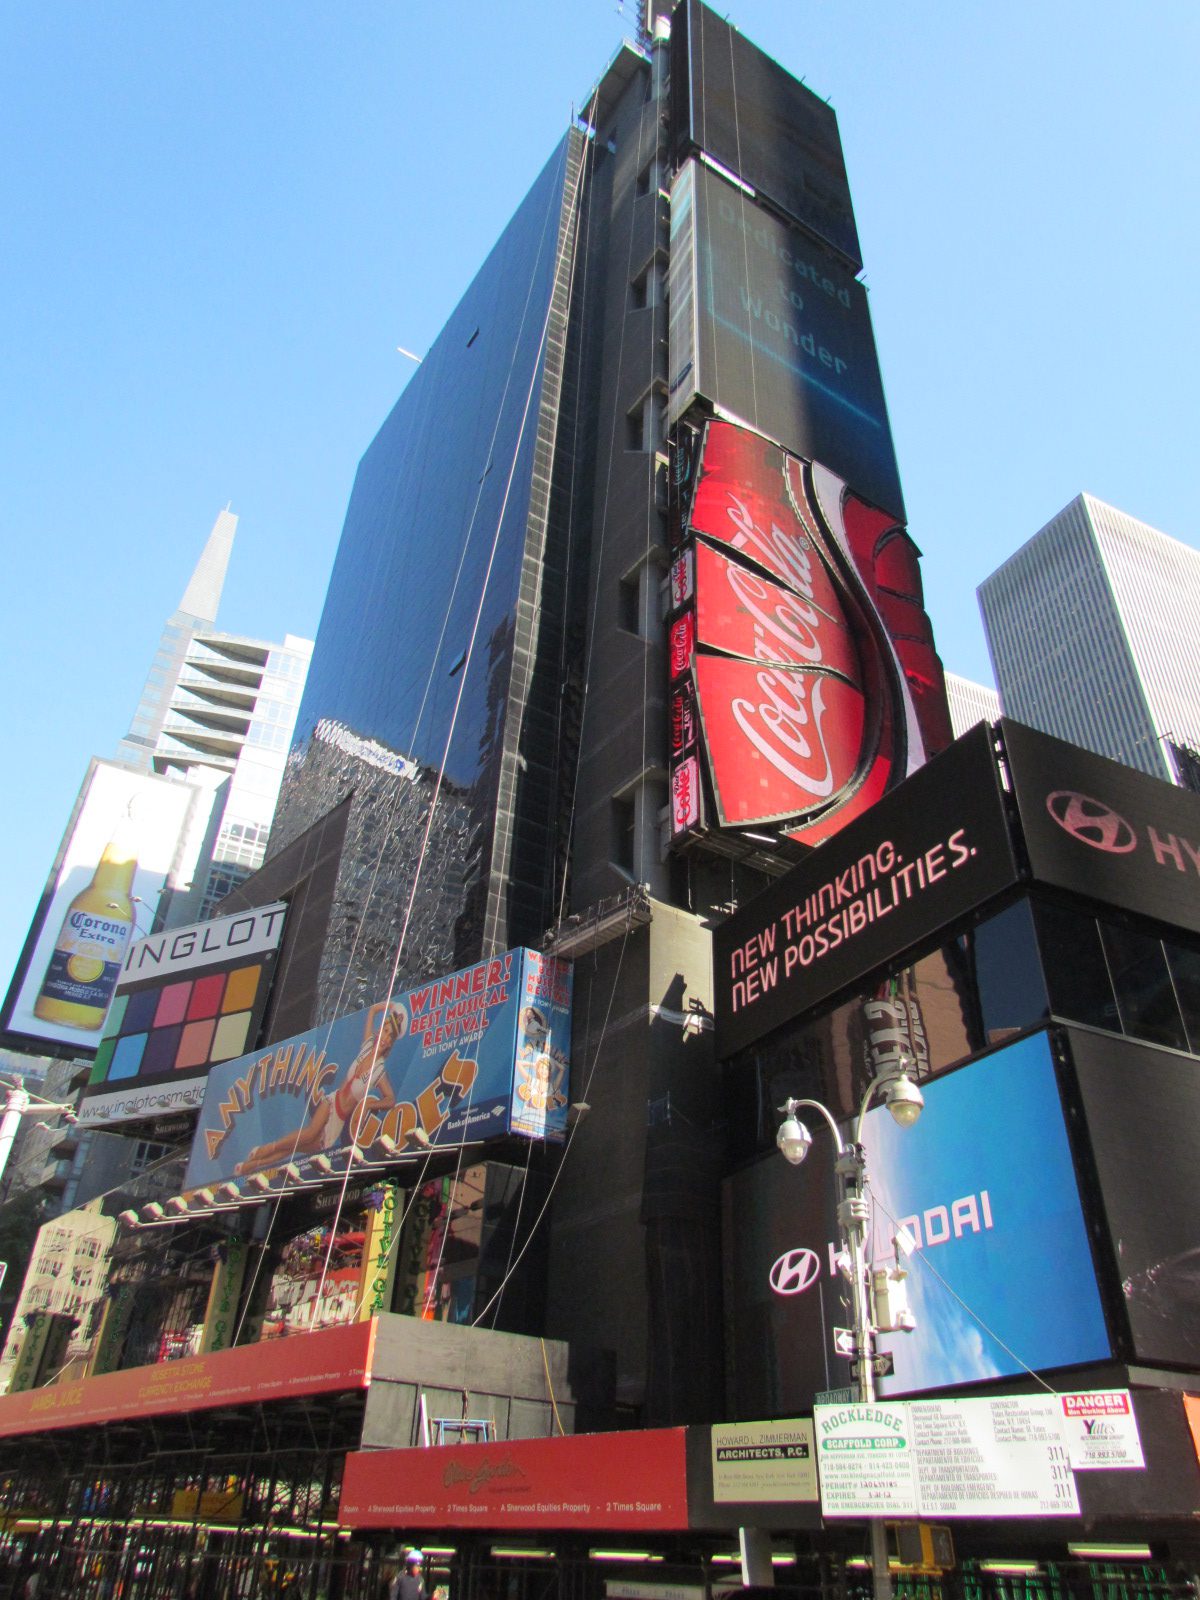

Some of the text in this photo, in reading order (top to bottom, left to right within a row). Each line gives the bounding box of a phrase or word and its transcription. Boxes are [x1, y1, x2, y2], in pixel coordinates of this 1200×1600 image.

[719, 203, 851, 309] Dedicated
[776, 280, 803, 311] to
[739, 286, 847, 374] Wonder
[780, 840, 903, 941] THINKING.
[784, 828, 978, 979] POSSIBILITIES.
[70, 911, 127, 936] Corona
[79, 928, 116, 945] Extra
[125, 908, 286, 972] INGLOT
[408, 954, 513, 1018] WINNER!
[410, 985, 509, 1036] BEST MUSICAL
[422, 1009, 489, 1049] REVIVAL
[438, 1038, 458, 1054] TONY
[459, 1030, 485, 1047] AWARD
[205, 1043, 339, 1160] ANYTHING
[350, 1048, 479, 1151] GOES
[1066, 1394, 1124, 1408] DANGER
[1106, 1406, 1126, 1414] Above
[821, 1408, 903, 1434] ROCKLEDGE
[1083, 1419, 1115, 1435] Yates
[716, 1435, 750, 1446] HOWARD
[760, 1432, 807, 1444] ZIMMERMAN
[827, 1438, 902, 1450] SCAFFOLD CORP.
[719, 1447, 807, 1459] ARCHITECTS, P.C.
[1047, 1446, 1065, 1461] 311
[1050, 1464, 1069, 1480] 311
[827, 1492, 856, 1500] EXPIRES
[1055, 1483, 1072, 1498] 311
[415, 1505, 436, 1514] Property
[452, 1504, 468, 1512] Times
[469, 1504, 488, 1513] Square
[506, 1503, 536, 1511] Sherwood
[537, 1503, 560, 1512] Equities
[562, 1503, 590, 1513] Property
[606, 1502, 611, 1511] 2
[613, 1502, 634, 1511] Times
[635, 1501, 662, 1512] Square
